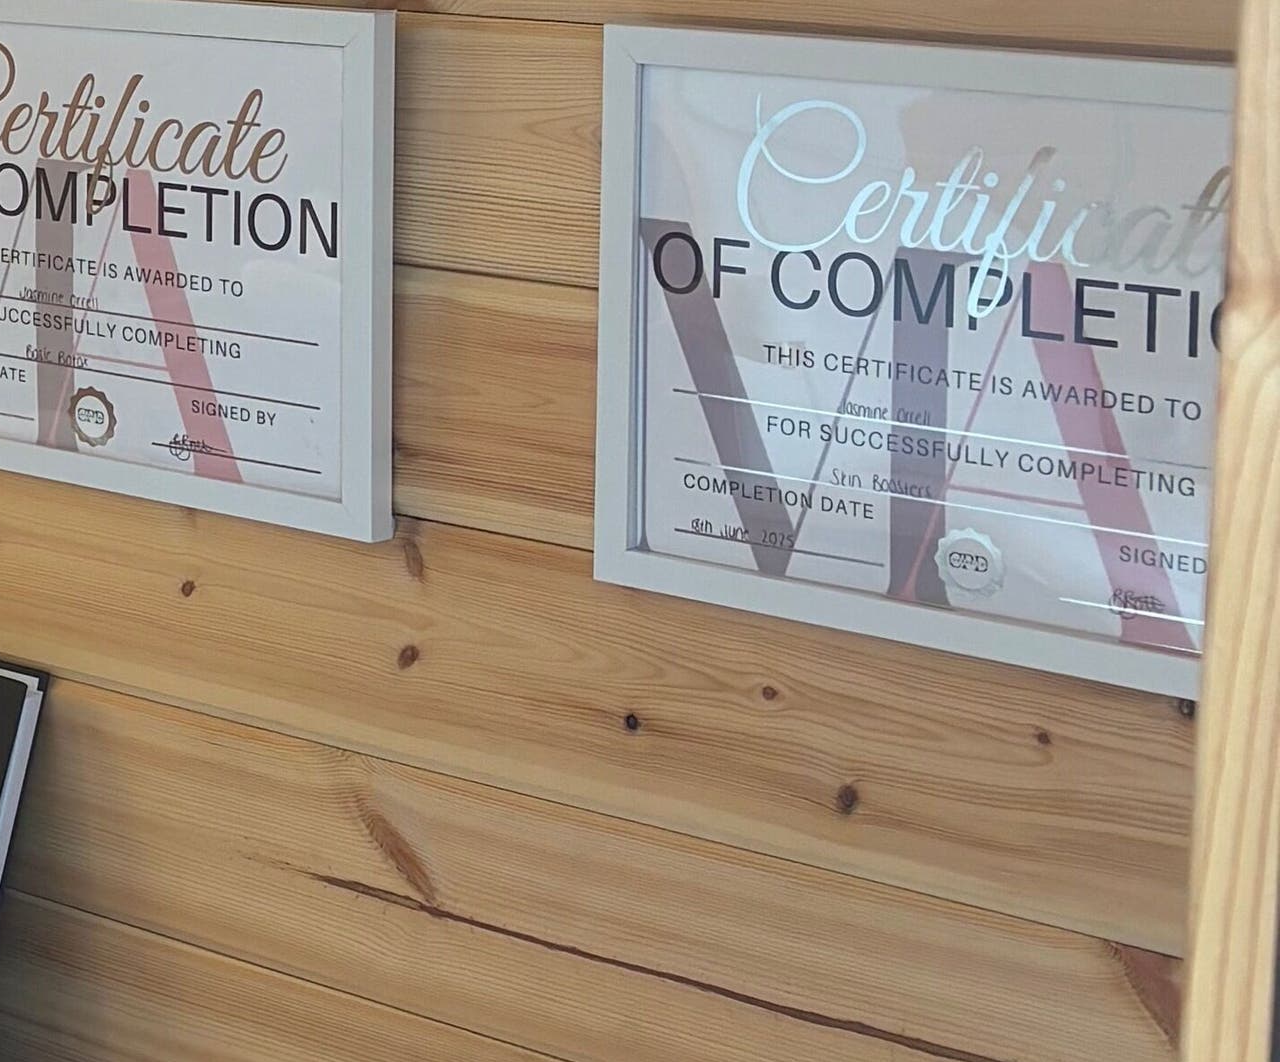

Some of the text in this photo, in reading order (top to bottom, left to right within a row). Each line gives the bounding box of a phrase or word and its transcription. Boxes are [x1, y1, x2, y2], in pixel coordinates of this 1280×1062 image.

[103, 261, 117, 279] IS
[124, 265, 212, 294] AWARDED
[218, 277, 243, 297] TO
[653, 231, 1222, 359] OF COMPLETI
[122, 326, 241, 360] COMPLETING
[763, 344, 1202, 421] THIS CERTIFICATE IS AWARDED TO
[191, 399, 276, 426] SIGNED BY
[838, 401, 889, 421] Jasmine
[767, 415, 1196, 498] FOR SUCCESSFULLY COMPLETING
[683, 473, 874, 520] COMPLETION DATE
[1119, 545, 1207, 575] SIGNED
